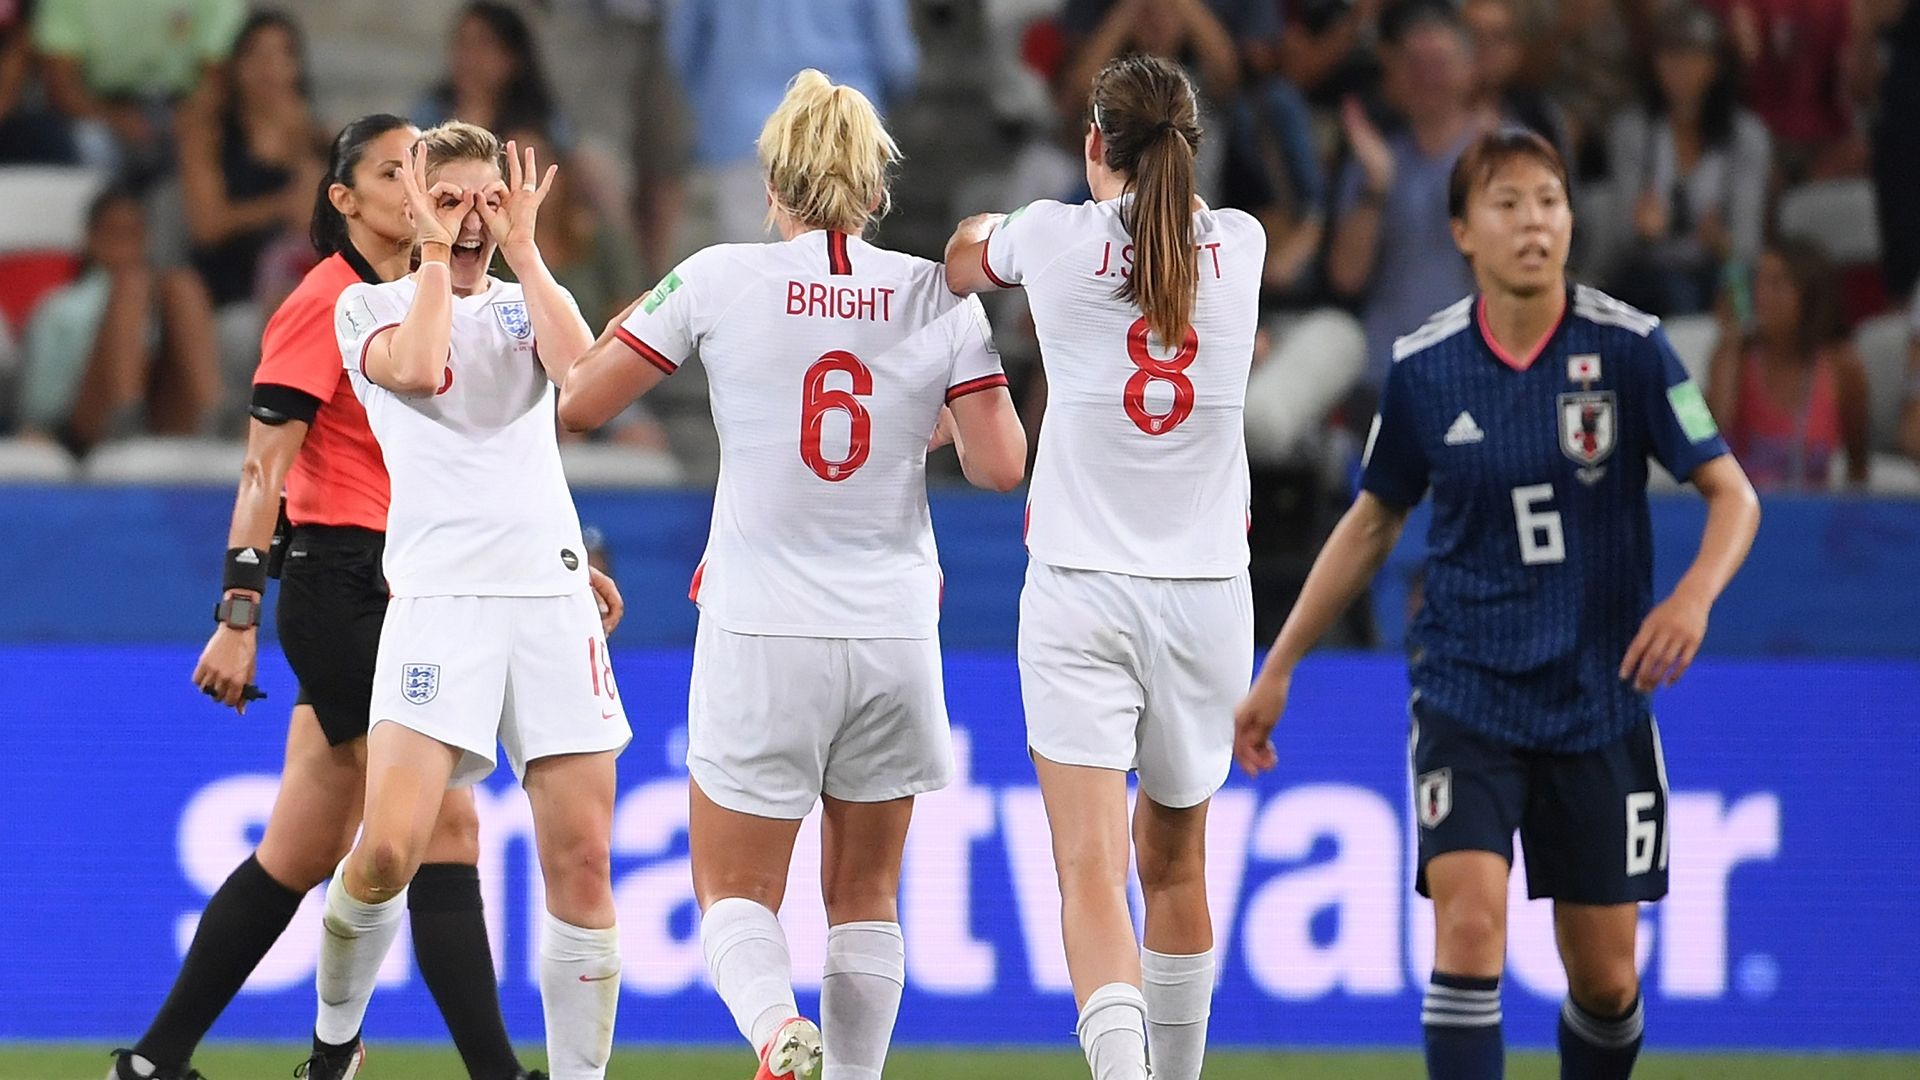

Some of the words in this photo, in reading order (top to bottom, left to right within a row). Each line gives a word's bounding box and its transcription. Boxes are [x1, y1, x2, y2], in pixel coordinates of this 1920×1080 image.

[786, 280, 895, 322] BRIGHT
[1094, 242, 1222, 279] J.ST
[799, 349, 874, 483] 6
[1123, 315, 1199, 437] 8
[1511, 483, 1566, 566] 6
[588, 636, 616, 701] 18
[177, 727, 1780, 999] satwar
[1625, 790, 1657, 878] 6
